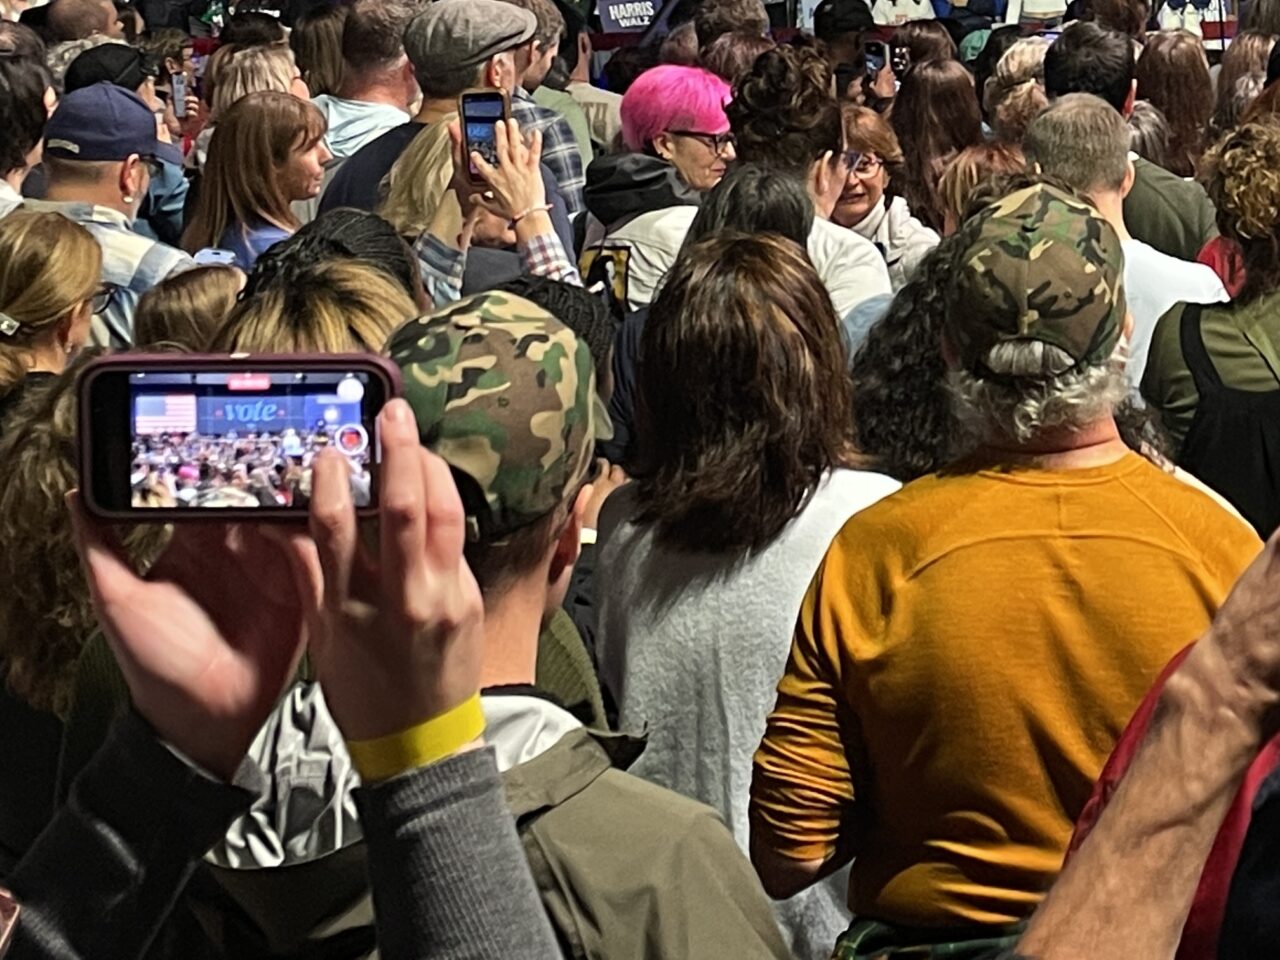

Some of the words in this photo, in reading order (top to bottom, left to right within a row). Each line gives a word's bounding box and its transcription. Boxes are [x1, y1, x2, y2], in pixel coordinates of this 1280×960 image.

[609, 1, 654, 21] HARRIS
[618, 16, 650, 28] WALZ
[224, 400, 277, 421] vote
